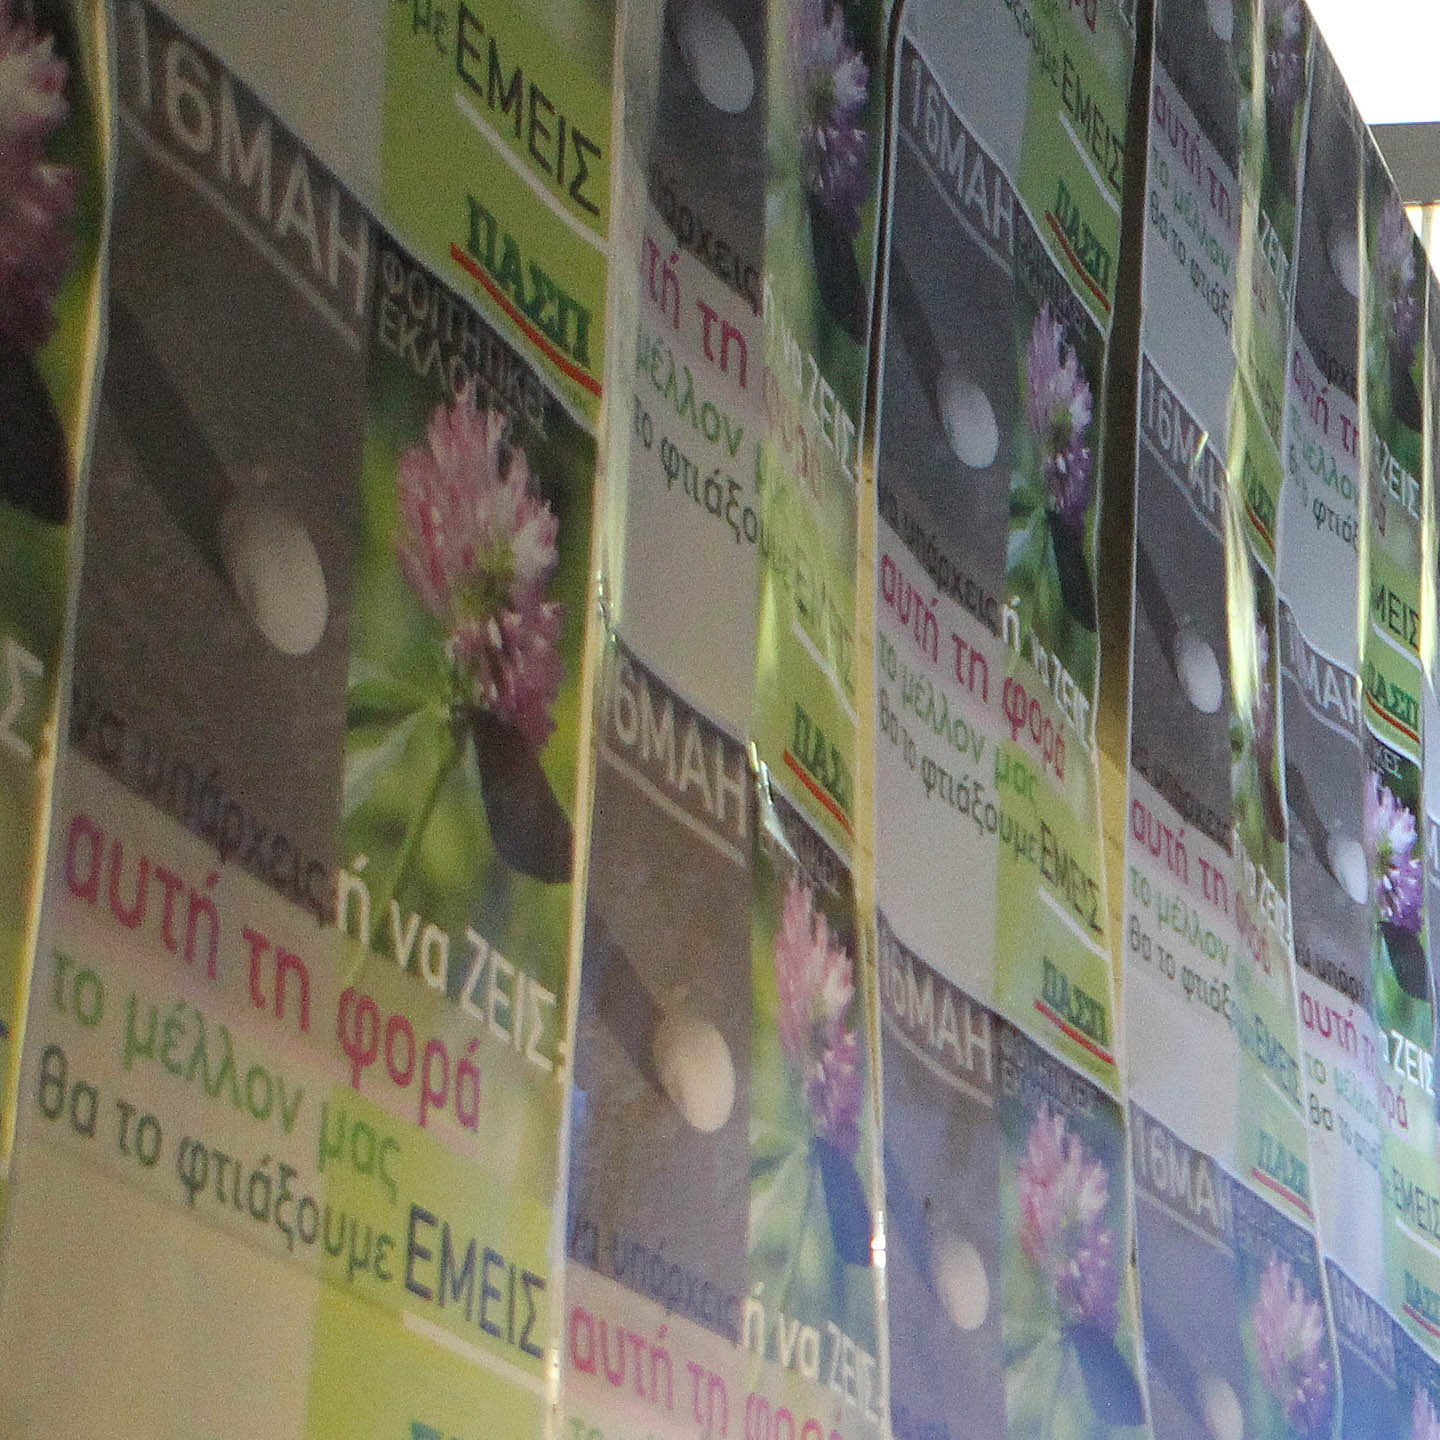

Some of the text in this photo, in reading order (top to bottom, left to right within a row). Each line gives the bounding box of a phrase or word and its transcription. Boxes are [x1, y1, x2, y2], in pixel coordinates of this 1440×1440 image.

[455, 5, 601, 215] ΕΜΕΙΣ
[911, 58, 1016, 257] 16ΜΑΗ
[466, 197, 591, 369] ΠΑΣΠ
[697, 300, 748, 390] τη
[881, 554, 940, 664] αυτή
[951, 633, 989, 704] τη
[1001, 677, 1066, 781] φορά
[1001, 597, 1021, 654] ή
[337, 854, 371, 943] ή
[389, 910, 449, 989] να
[1131, 800, 1189, 885] αυτή
[1198, 857, 1229, 914] τη
[64, 814, 482, 1132] αυτή τη φορά
[1301, 991, 1358, 1059] αυτή
[52, 950, 402, 1196] το μέλλον μας
[1390, 1029, 1436, 1098] ΖΕΙΣ
[38, 1044, 548, 1361] θα το φτιάξουμε ΕΜΕΙΣ
[569, 1306, 674, 1411] αυτή
[742, 1281, 765, 1354] ή
[777, 1313, 820, 1380] να
